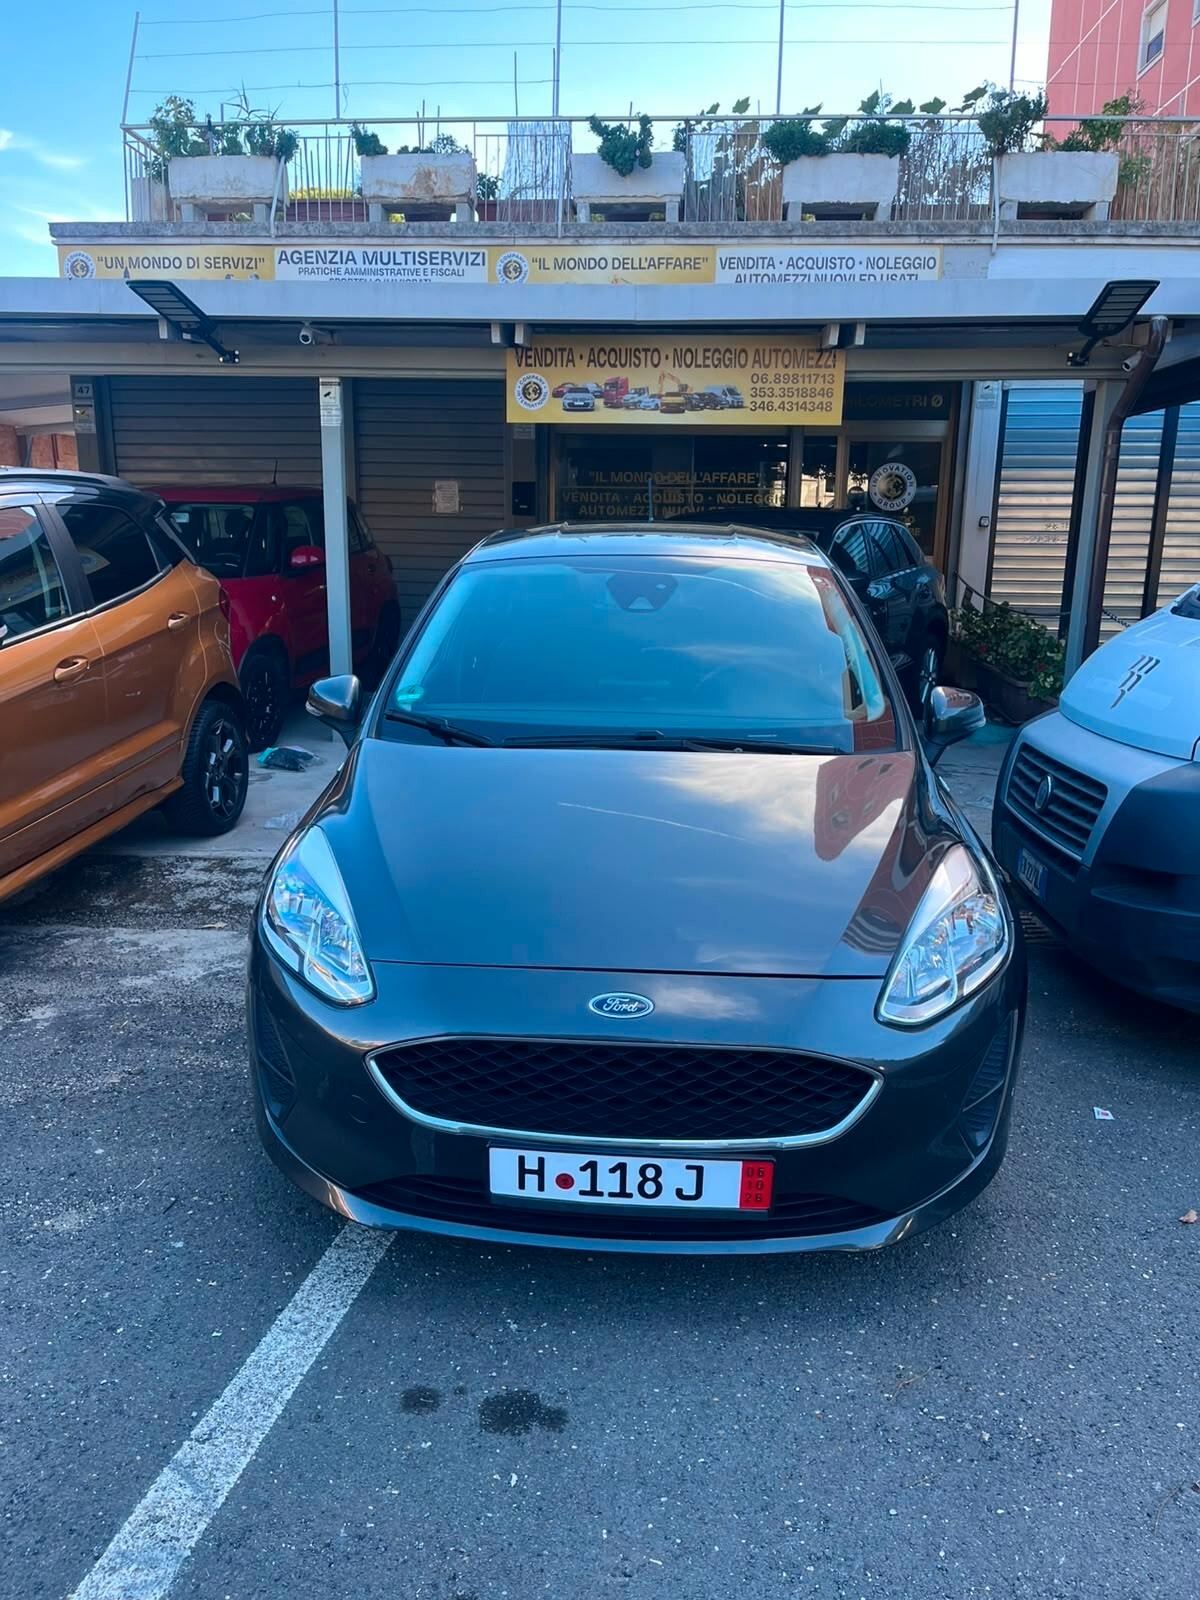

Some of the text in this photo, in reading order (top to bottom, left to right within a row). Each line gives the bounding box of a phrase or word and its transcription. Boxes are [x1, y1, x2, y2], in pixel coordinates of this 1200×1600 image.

[128, 256, 182, 270] MONDO
[186, 256, 200, 270] DI
[204, 256, 265, 270] SERVIZI"
[278, 250, 486, 266] AGENZIA MULTISERVIZI
[553, 257, 608, 271] MONDO
[719, 256, 937, 271] VENDITA ACQUISTO NOLEGGIO
[298, 267, 465, 277] PRATICHE AMMINISTRATIVE E FISCALI
[516, 347, 836, 369] VENDITA ACQUISTO NOLEGGIO AUTOMEZZI
[751, 372, 835, 385] 06.89811713
[77, 385, 90, 394] 47
[750, 386, 834, 398] 353.3518846
[749, 400, 833, 412] 346.4314348
[871, 465, 914, 488] INNOVATION
[562, 491, 620, 503] VENDITA
[877, 498, 906, 508] GROUP
[602, 997, 639, 1012] Ford
[517, 1155, 705, 1201] H 118 J
